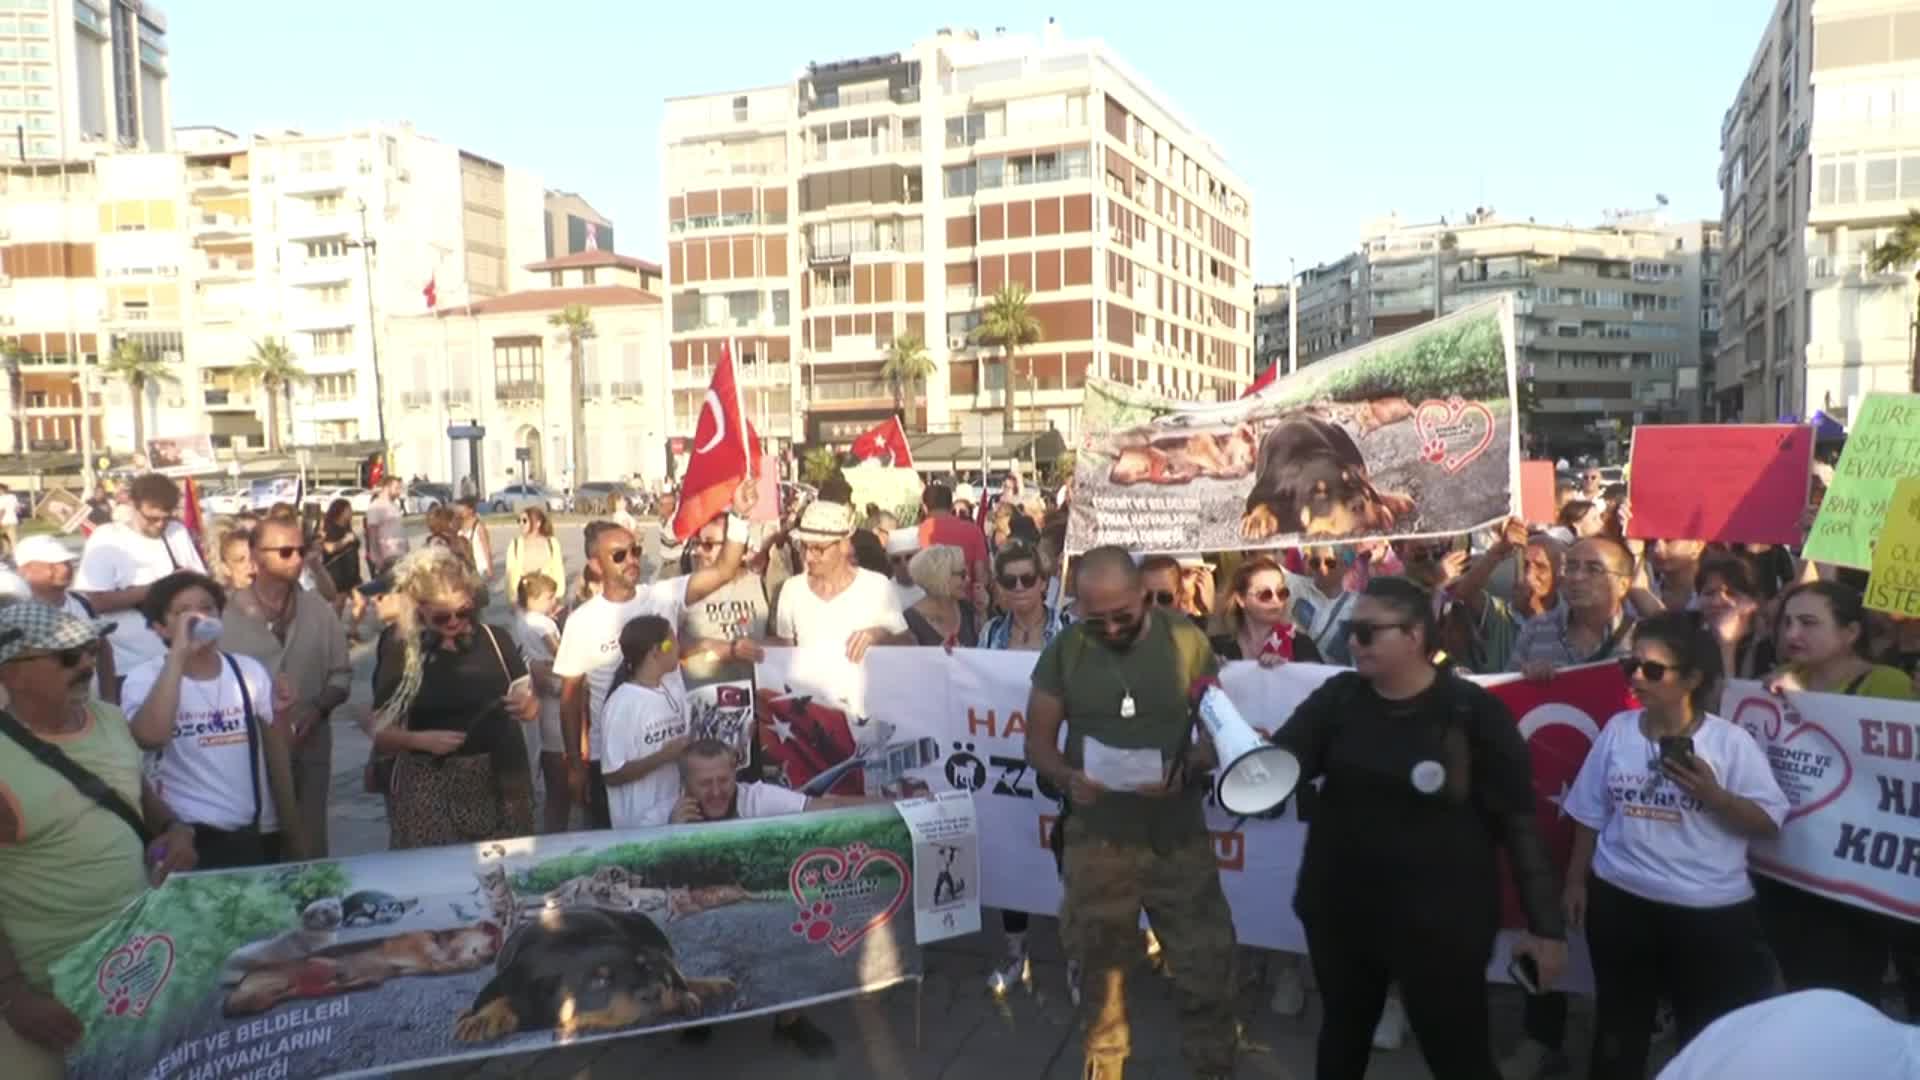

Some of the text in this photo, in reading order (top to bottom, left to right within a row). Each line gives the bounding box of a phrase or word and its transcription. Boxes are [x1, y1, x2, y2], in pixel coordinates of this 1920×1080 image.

[1858, 718, 1920, 763] ED
[205, 1030, 232, 1053] VE
[236, 995, 350, 1044] BELDELERİ
[188, 1026, 333, 1080] HAYVANLARINI
